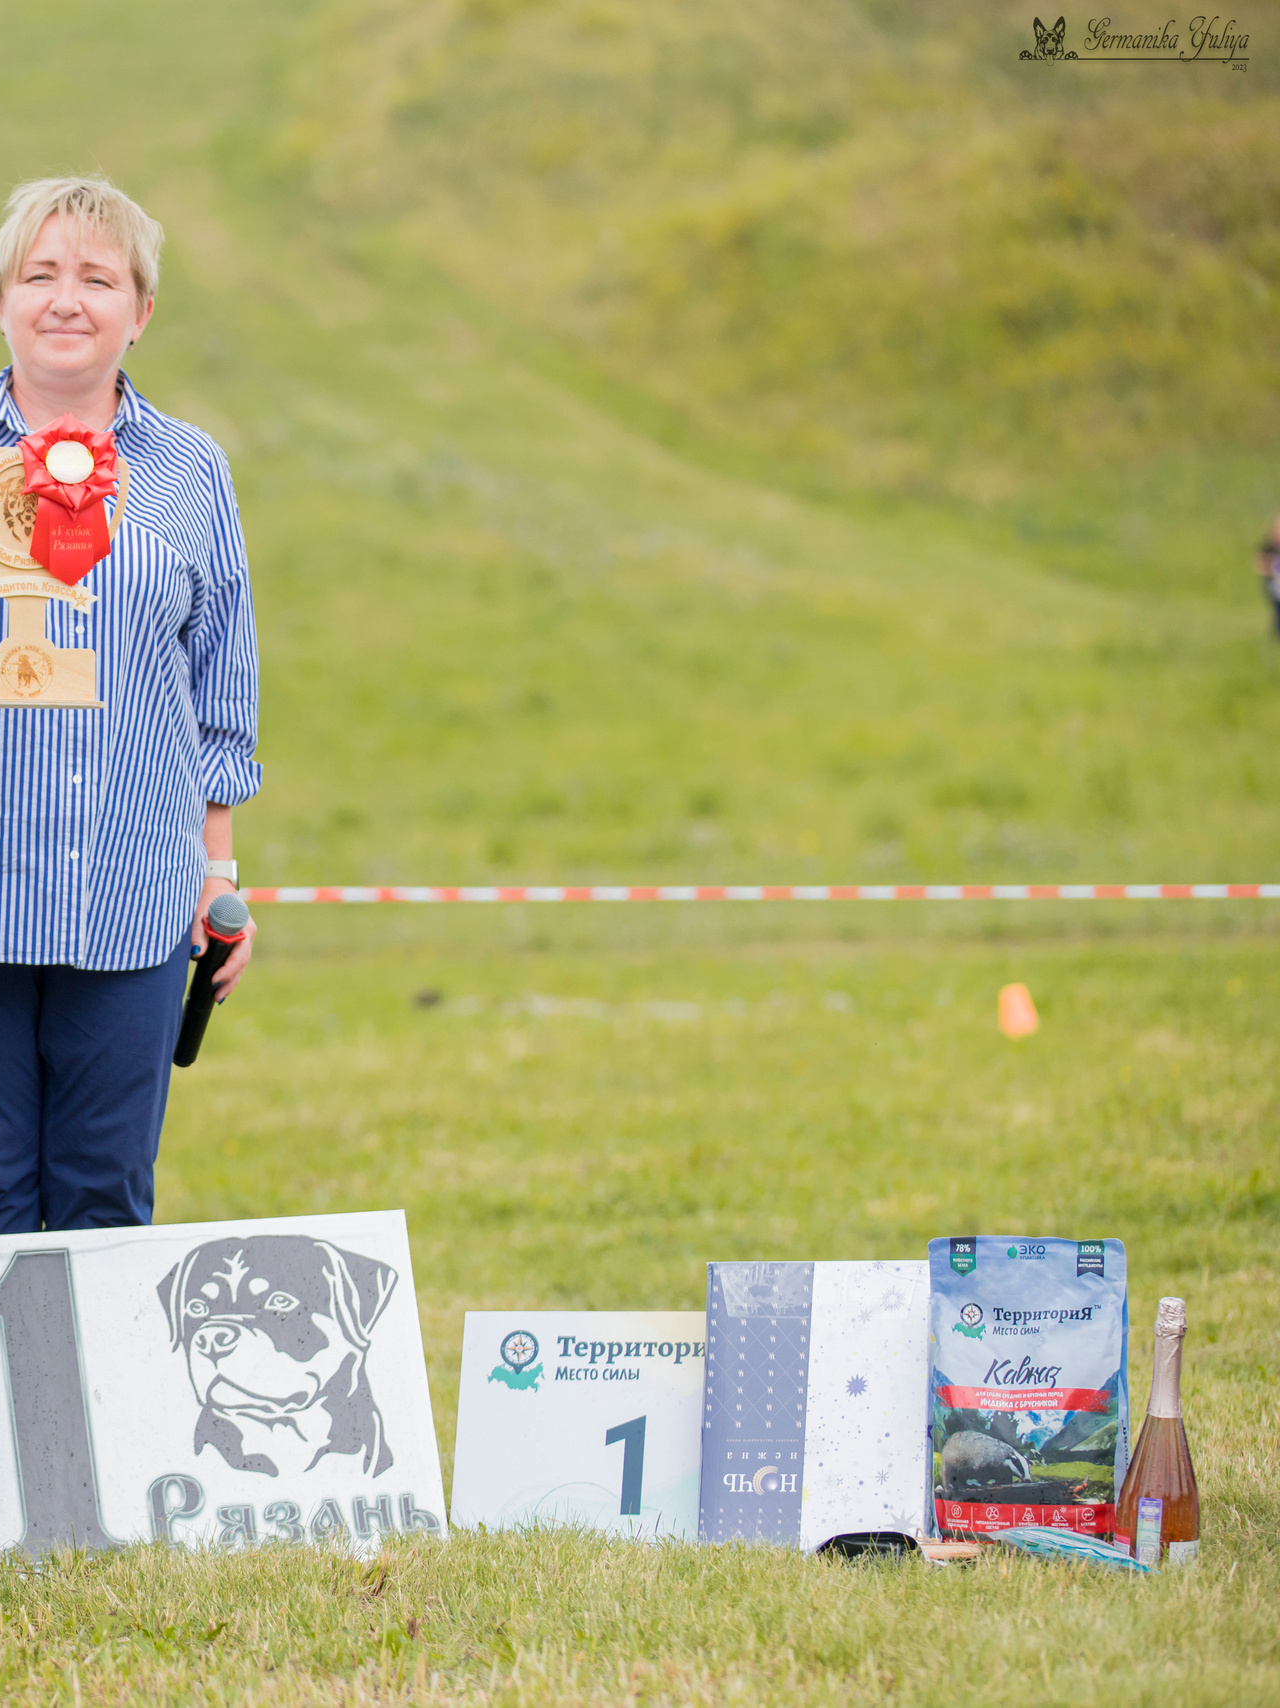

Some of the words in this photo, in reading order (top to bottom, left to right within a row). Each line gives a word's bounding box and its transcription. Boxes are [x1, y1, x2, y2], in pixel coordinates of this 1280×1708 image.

[65, 525, 92, 539] кубок
[53, 540, 93, 551] Рязани»
[42, 581, 77, 598] Класса
[955, 1244, 971, 1253] 78%
[1019, 1245, 1046, 1255] ЭКО
[1080, 1245, 1102, 1253] 100%
[983, 1355, 1062, 1389] Кавказ
[605, 1415, 647, 1515] 1
